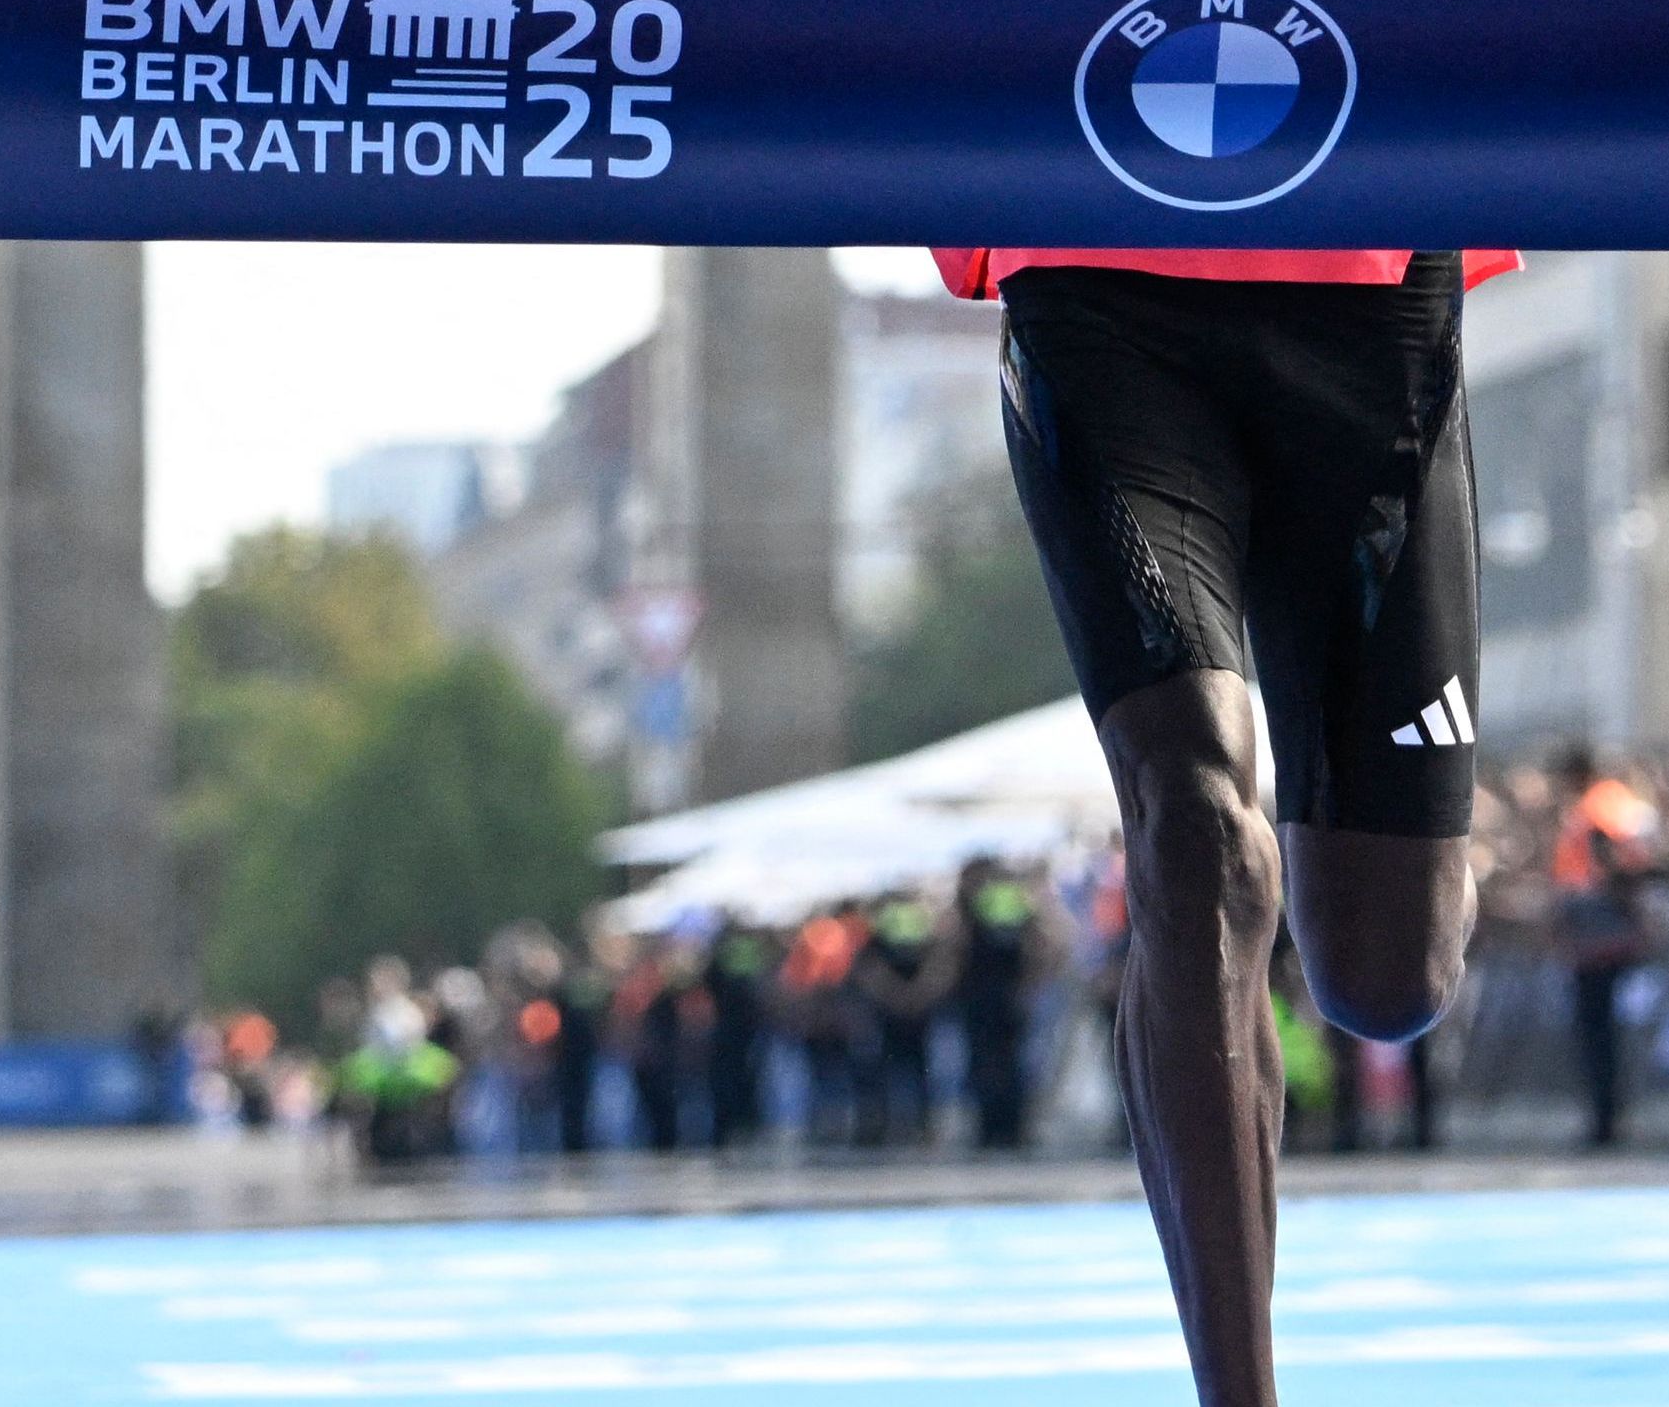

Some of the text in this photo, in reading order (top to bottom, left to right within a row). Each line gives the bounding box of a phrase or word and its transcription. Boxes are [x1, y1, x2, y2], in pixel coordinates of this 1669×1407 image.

[80, 50, 349, 105] BERLIN
[79, 115, 504, 177] MARATHON
[522, 84, 672, 179] 25
